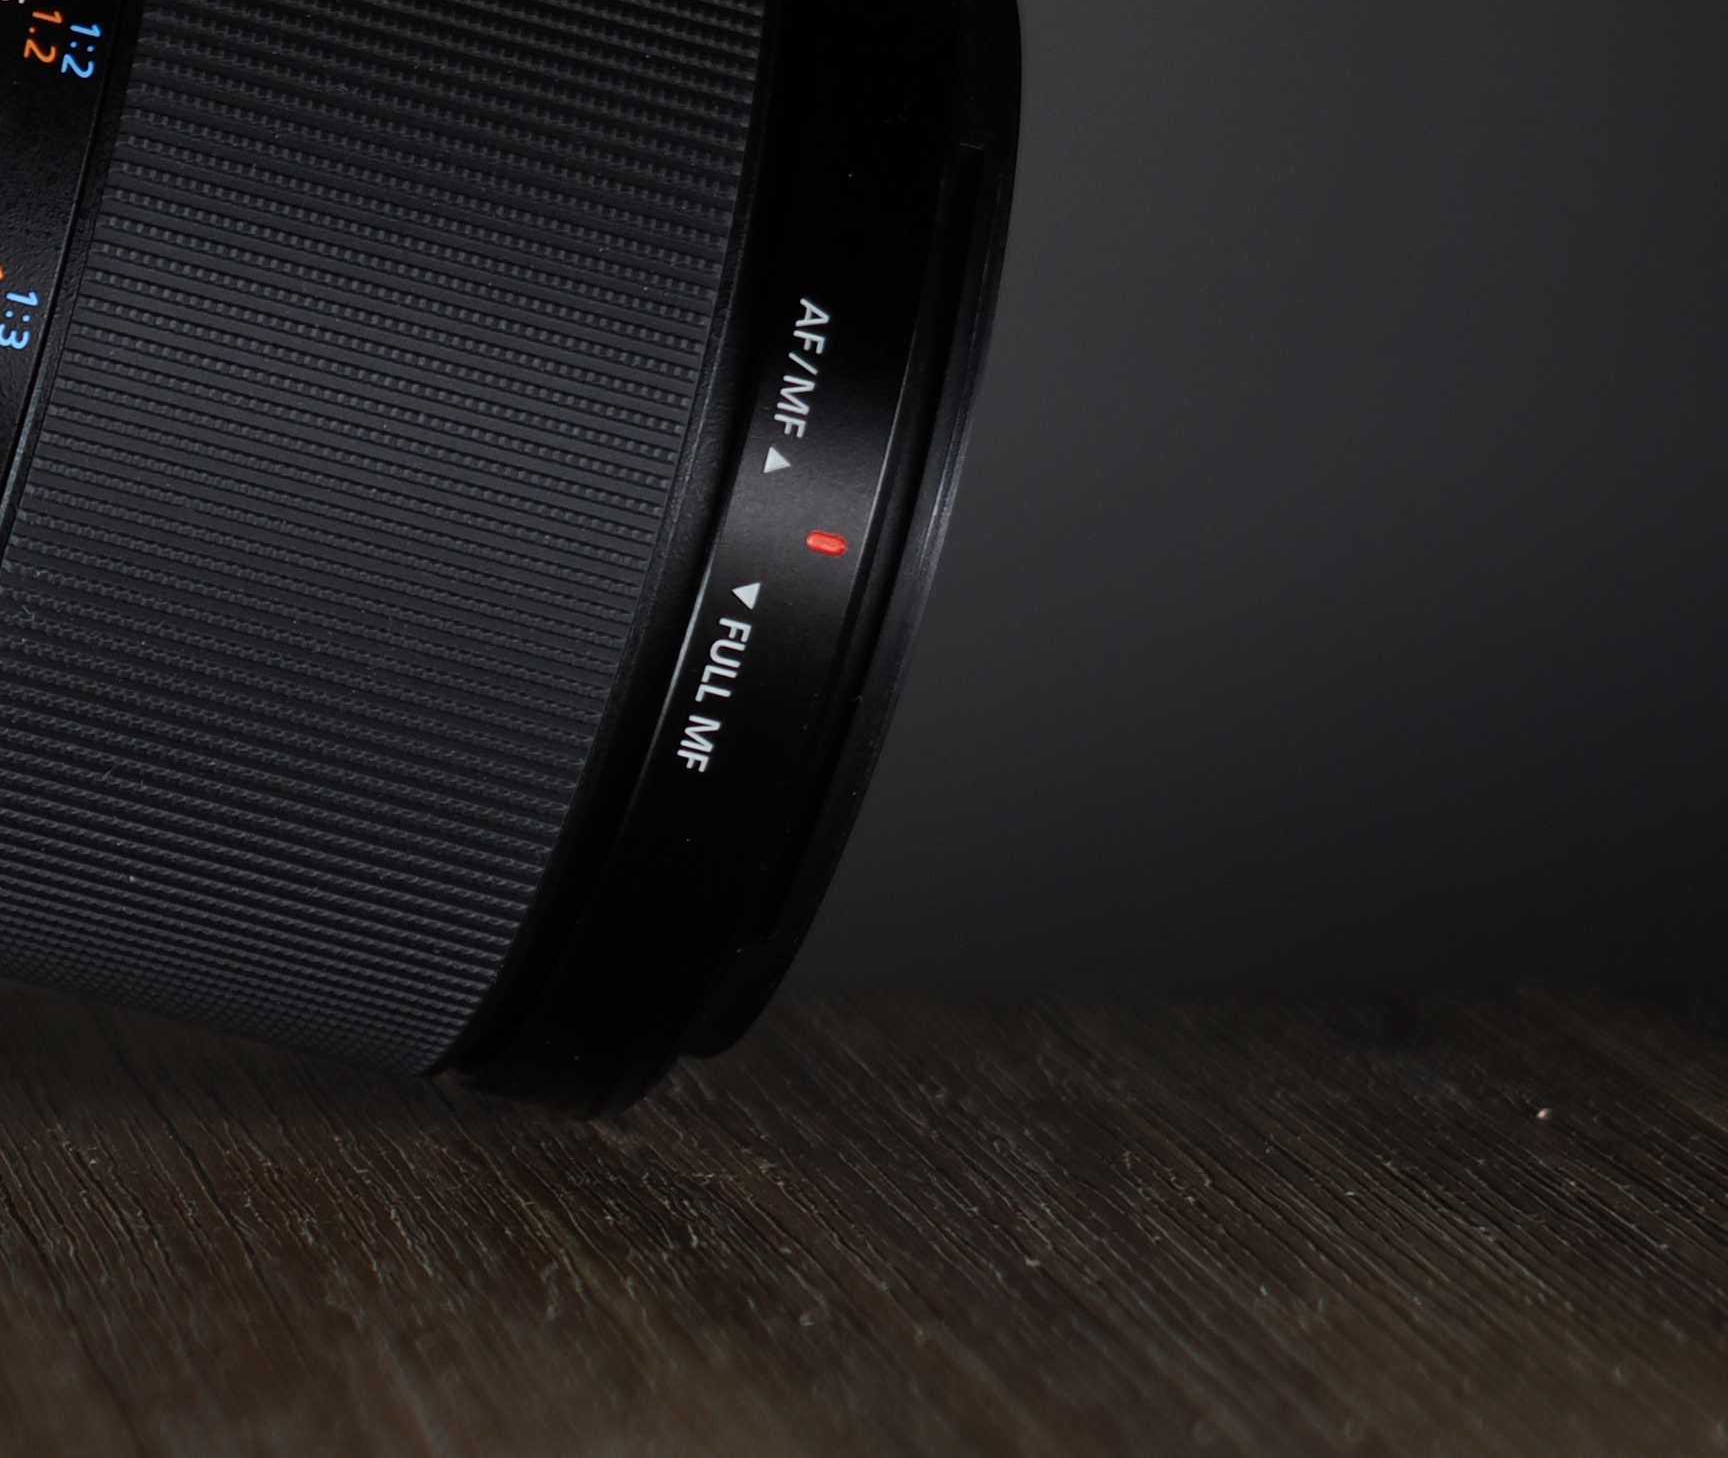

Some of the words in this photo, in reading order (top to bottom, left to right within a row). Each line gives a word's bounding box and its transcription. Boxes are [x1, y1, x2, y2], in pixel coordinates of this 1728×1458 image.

[22, 8, 65, 65] 1.2
[59, 21, 104, 80] 1:2
[773, 298, 830, 439] AF/MF
[694, 616, 752, 703] FULL
[676, 714, 722, 773] MF
